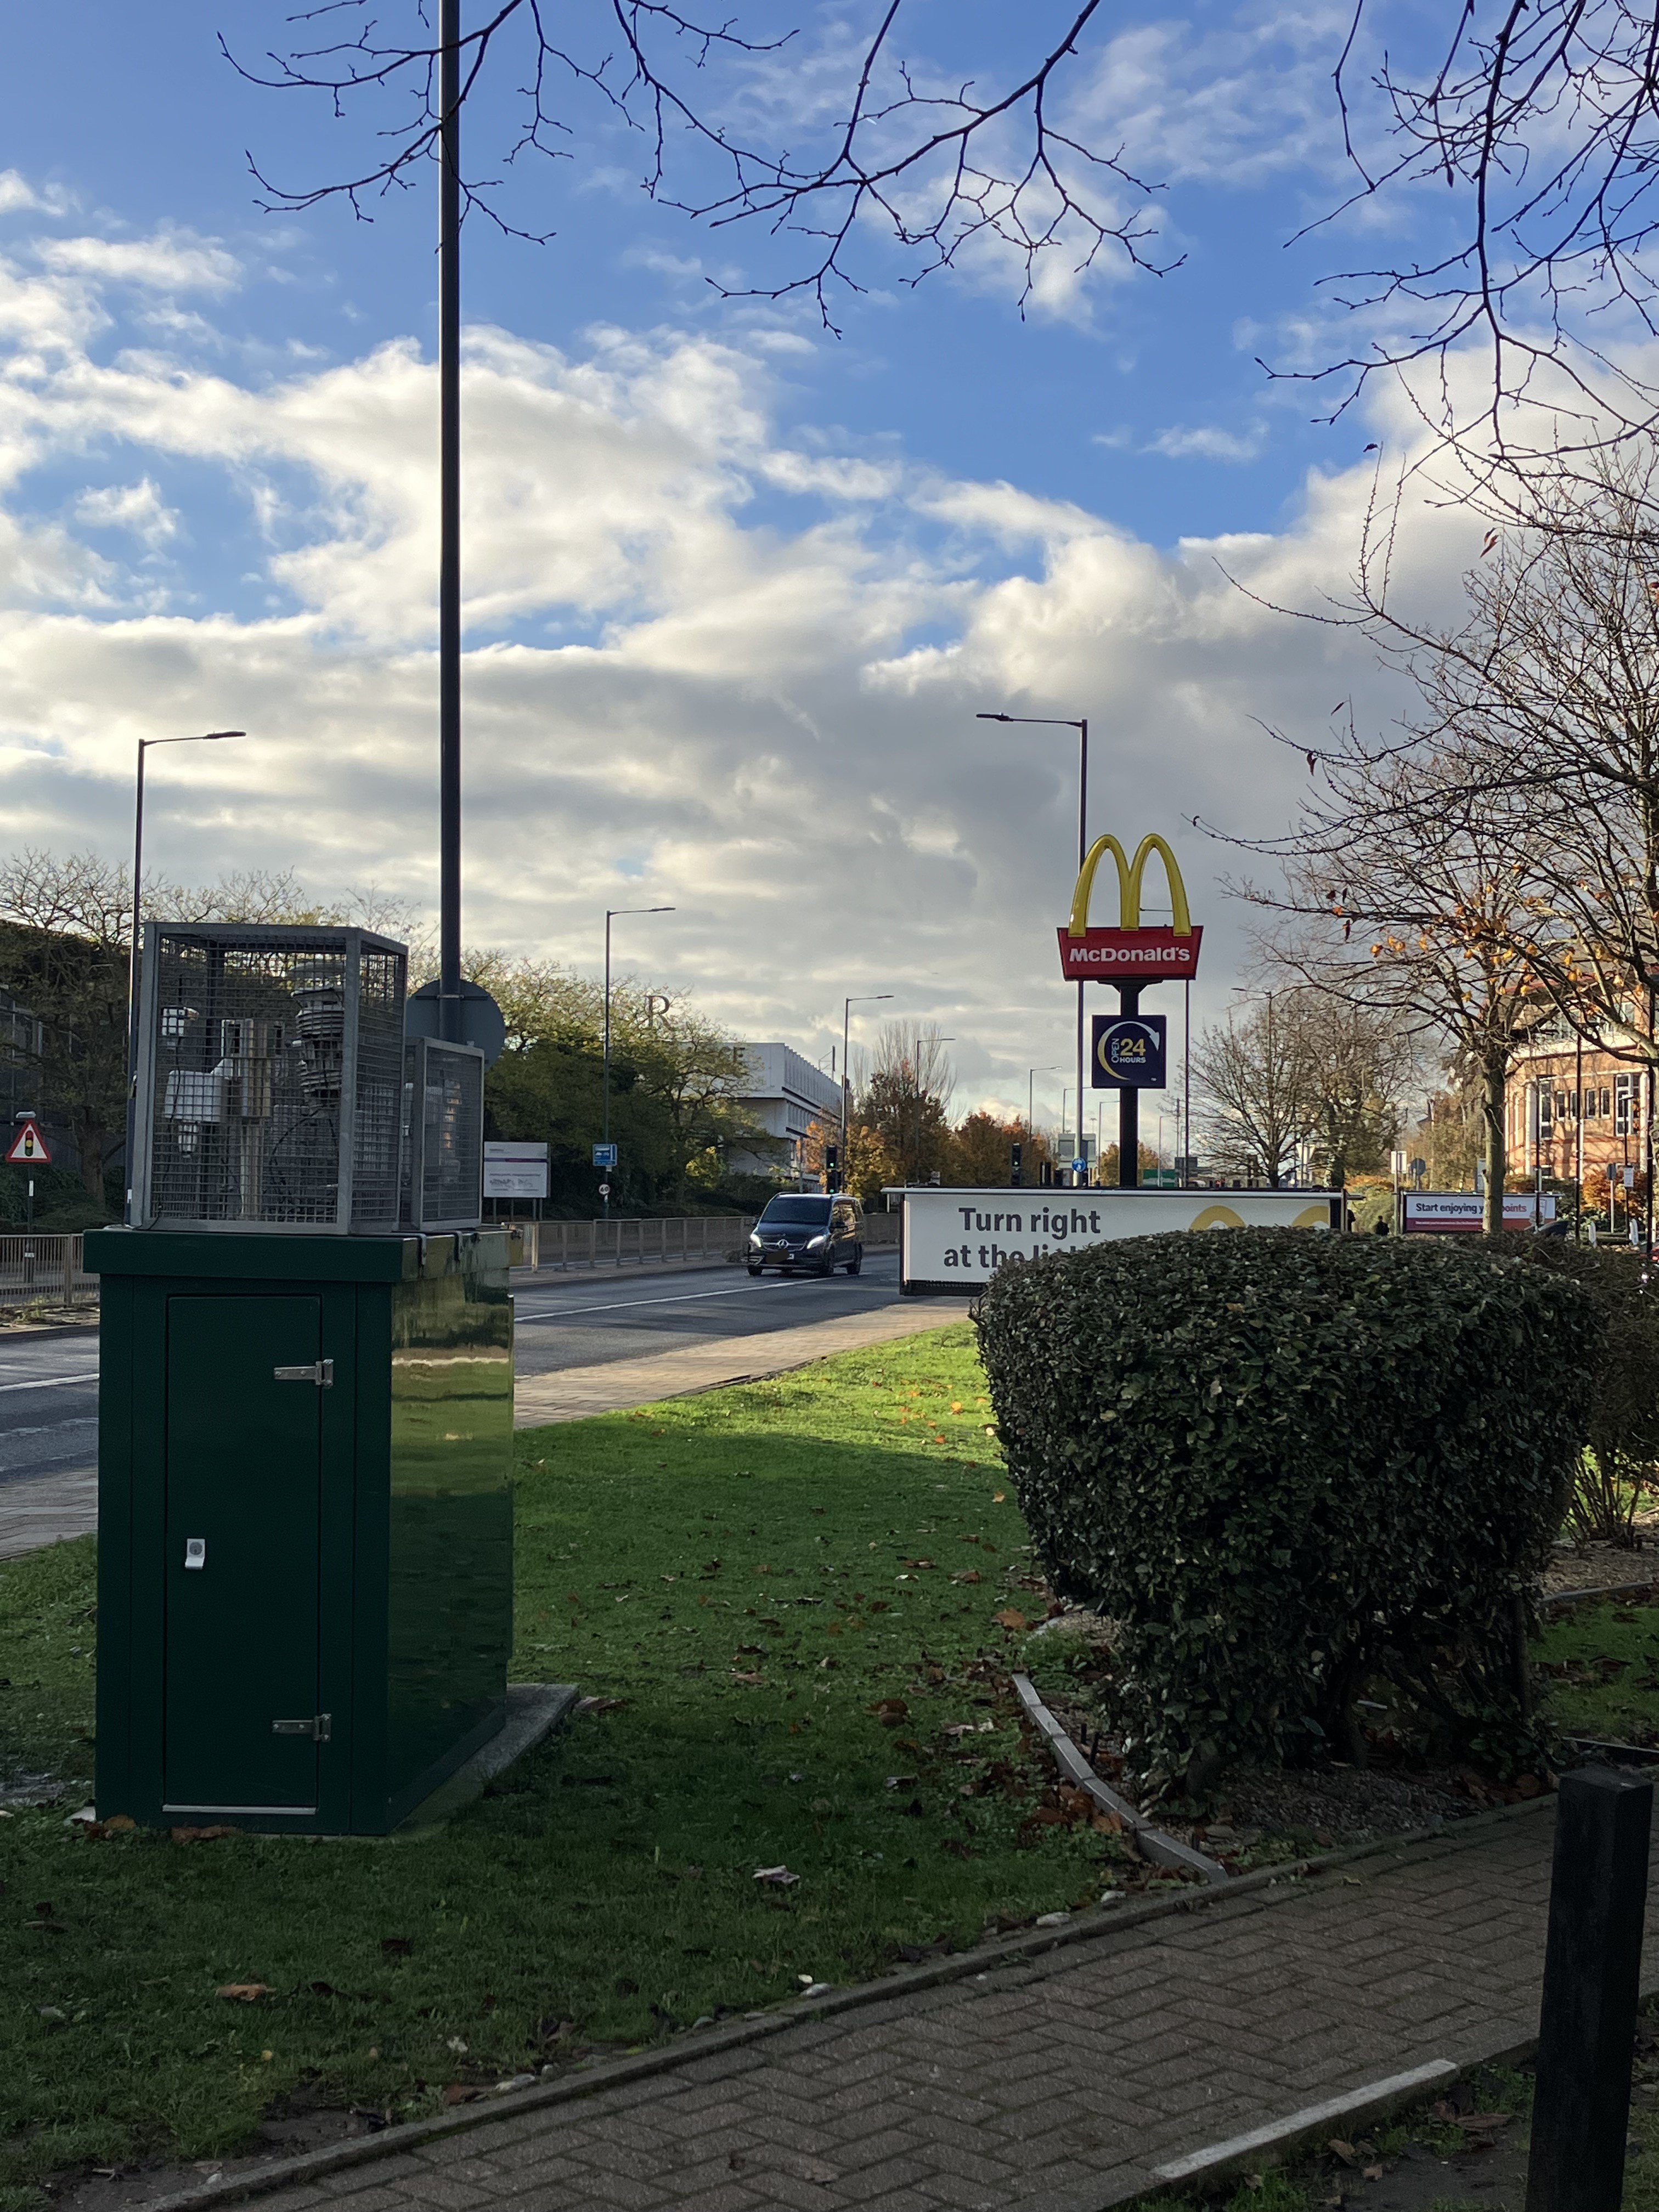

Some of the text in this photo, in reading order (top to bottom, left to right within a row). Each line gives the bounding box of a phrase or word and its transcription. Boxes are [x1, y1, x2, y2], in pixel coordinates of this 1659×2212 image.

[1069, 947, 1190, 962] McDonald's
[1111, 1038, 1120, 1063] OPEN
[1120, 1038, 1146, 1056] 24
[1415, 1203, 1438, 1212] Start
[1440, 1202, 1477, 1214] enjoying
[958, 1206, 1101, 1240] Turn right
[944, 1245, 972, 1267] at
